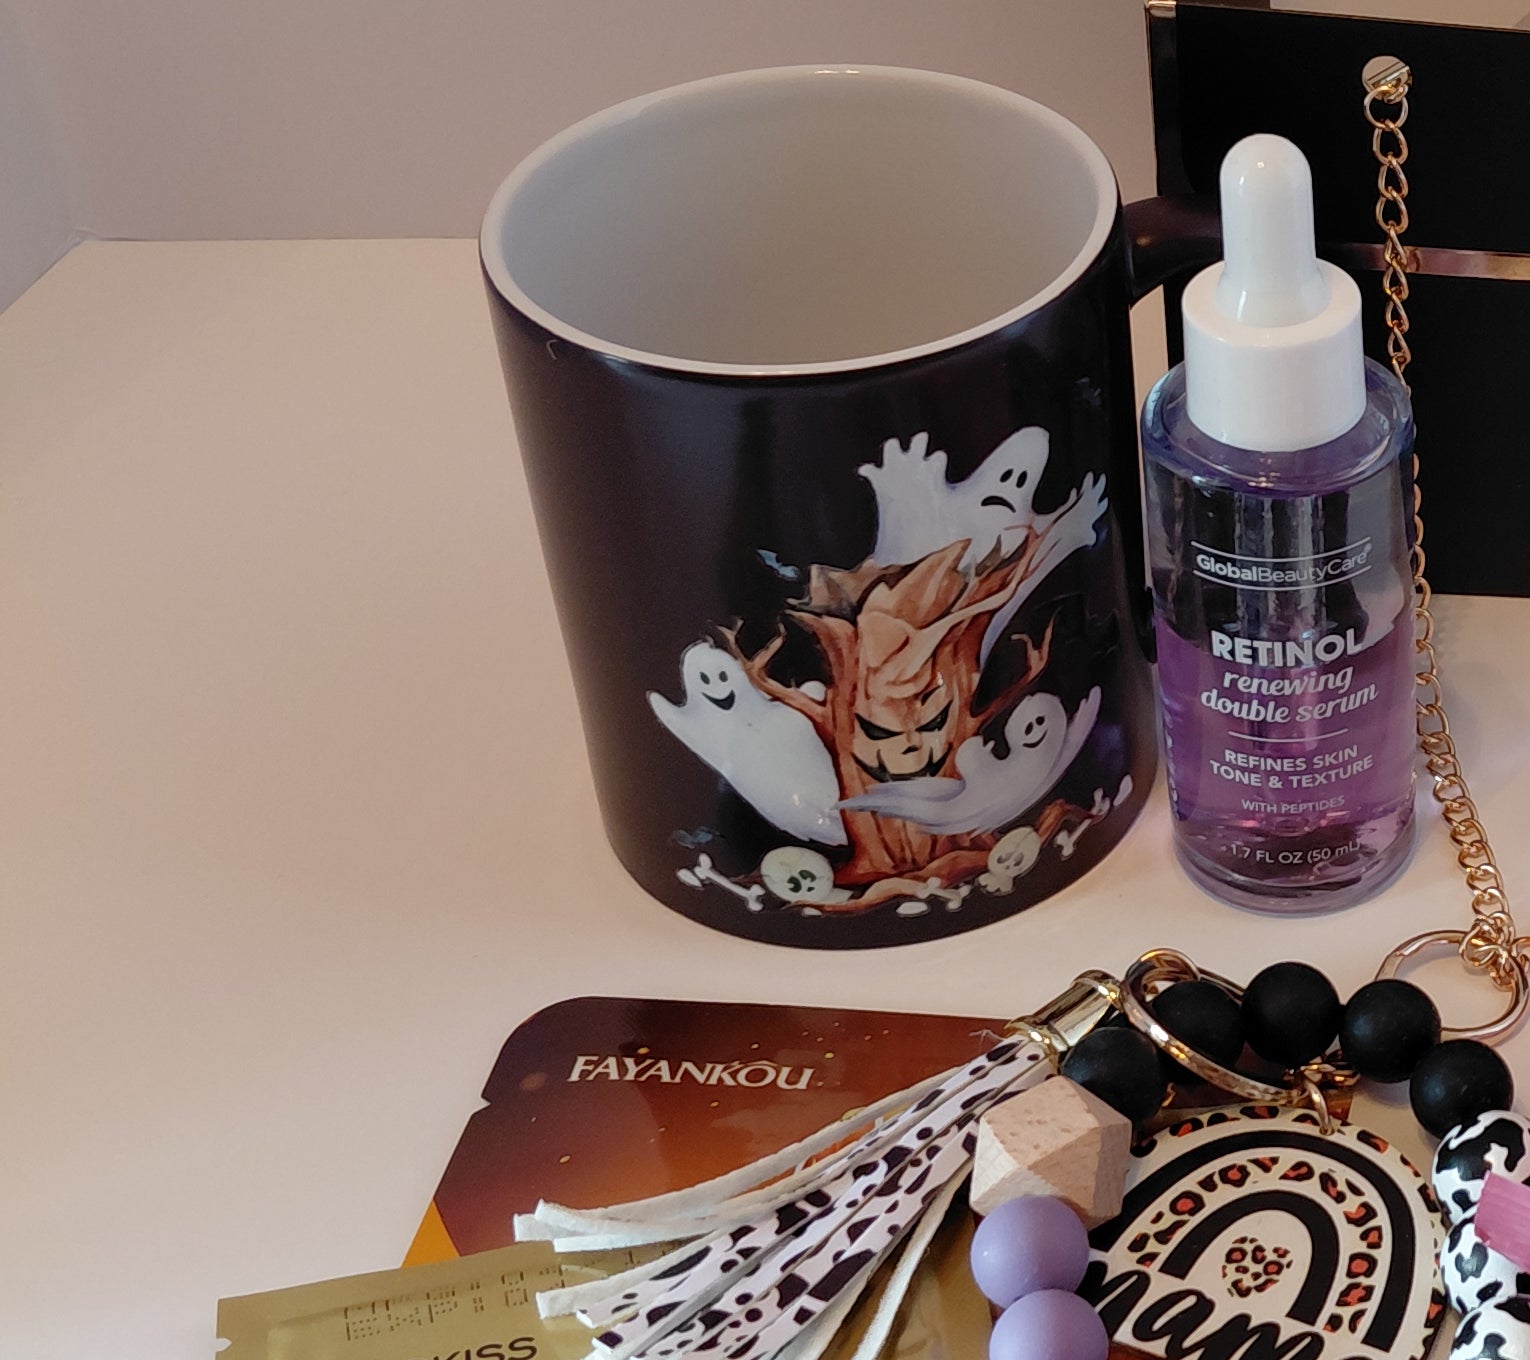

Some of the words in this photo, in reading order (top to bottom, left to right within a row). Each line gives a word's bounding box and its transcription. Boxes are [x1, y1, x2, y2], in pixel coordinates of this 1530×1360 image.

[1211, 628, 1363, 667] RETINOL
[1223, 667, 1354, 695] renewing
[1201, 688, 1290, 722] double
[1296, 684, 1378, 721] serum
[1210, 760, 1262, 787] TONE
[1268, 775, 1283, 788] &
[1289, 754, 1373, 788] TEXTURE
[1225, 749, 1307, 772] REFINES
[1312, 745, 1357, 768] SKIN
[1241, 799, 1277, 813] WITH
[1281, 795, 1345, 814] PEPTIDES
[1256, 850, 1274, 864] FL
[1278, 851, 1303, 864] OZ
[1307, 848, 1331, 864] (50
